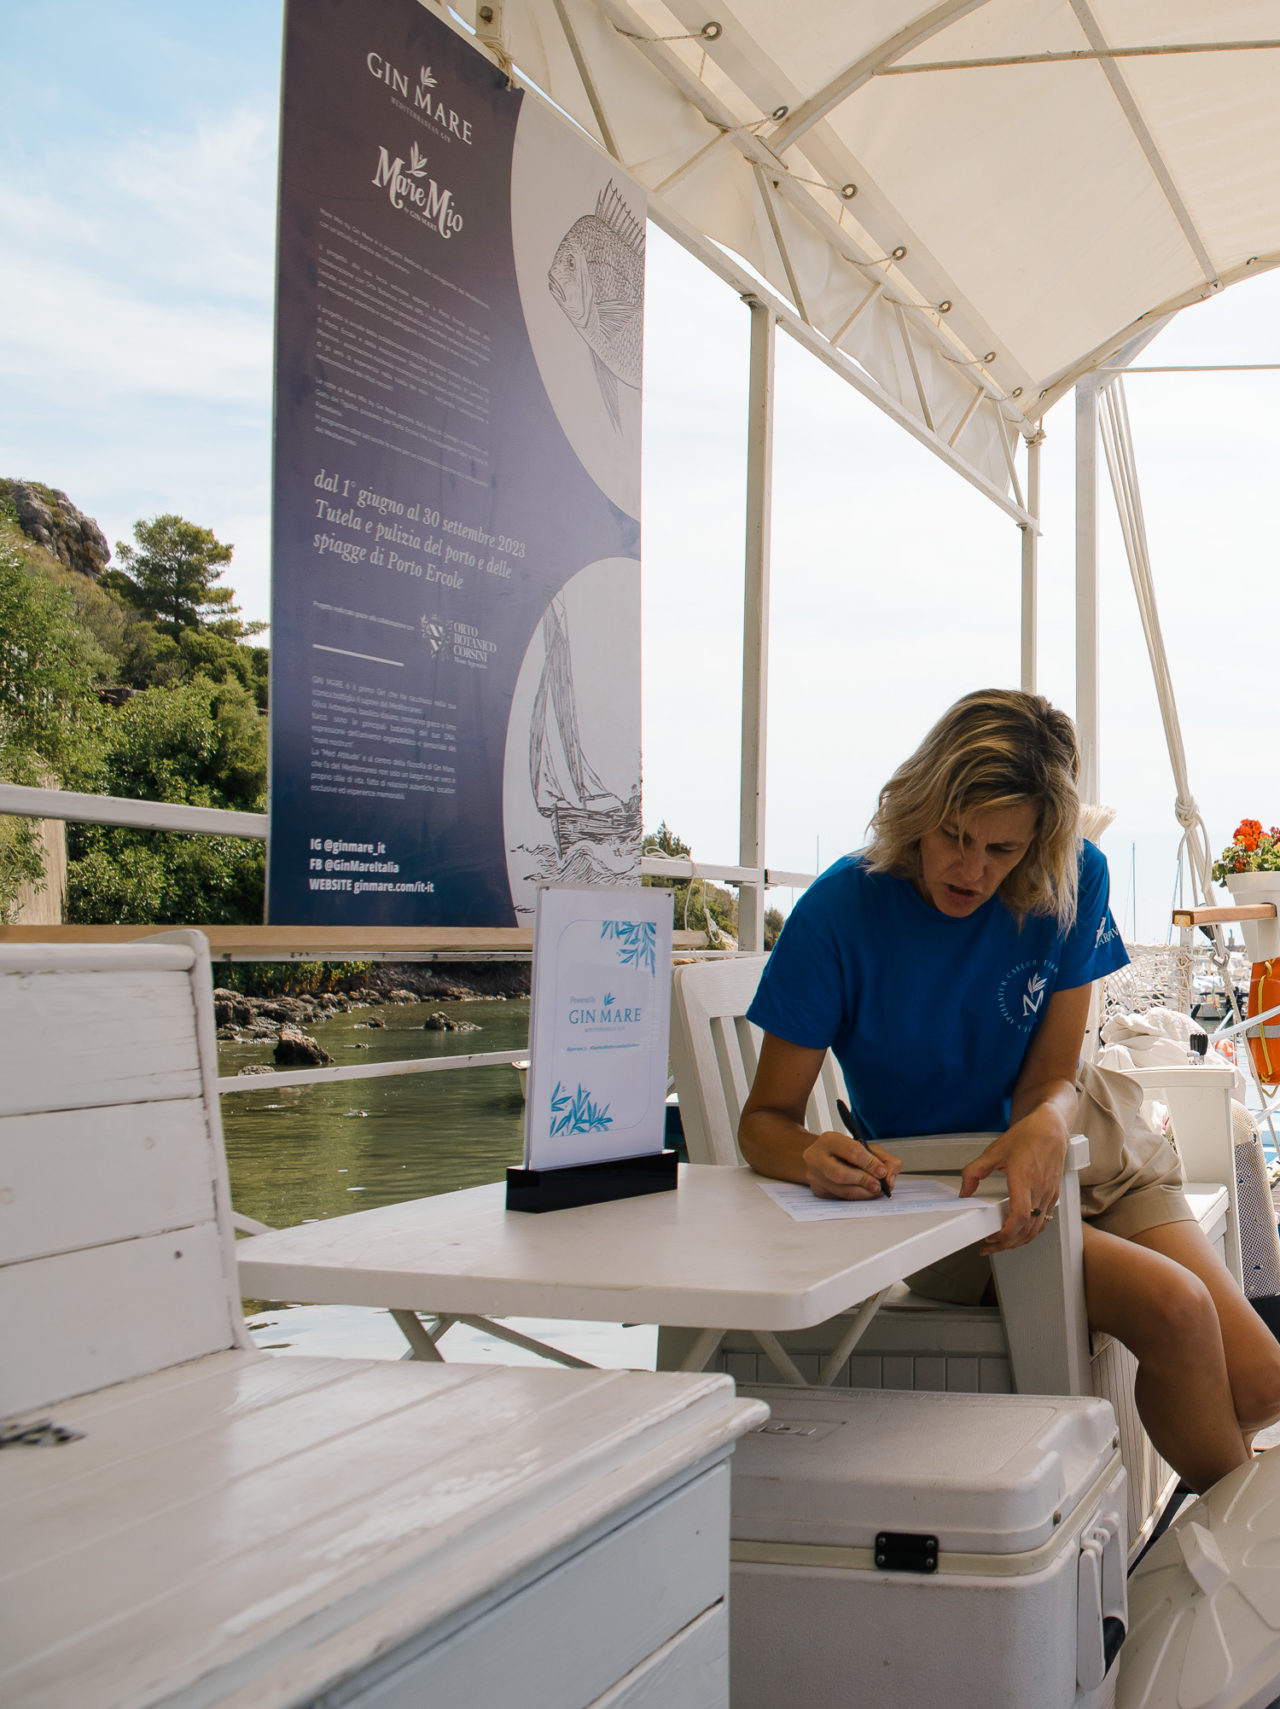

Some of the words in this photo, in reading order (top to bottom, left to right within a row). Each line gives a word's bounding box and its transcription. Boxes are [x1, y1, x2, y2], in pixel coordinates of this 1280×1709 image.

[367, 52, 409, 98] GIN
[413, 85, 473, 145] MARE
[371, 145, 426, 209] Mare
[422, 178, 463, 239] Mio
[314, 469, 338, 493] dal
[357, 486, 404, 515] giugno
[407, 504, 420, 521] al
[423, 507, 440, 528] 30
[442, 517, 495, 548] settembre
[498, 535, 526, 559] 2023
[315, 499, 361, 530] Tutela
[365, 521, 373, 533] e
[375, 522, 420, 549] pulizia
[424, 535, 443, 557] del
[445, 545, 475, 565] porto
[477, 557, 484, 570] e
[486, 556, 512, 579] delle
[313, 532, 366, 564] spiagge
[370, 546, 384, 566] di
[387, 552, 422, 578] Porto
[425, 563, 464, 590] Ercole
[453, 622, 478, 638] ORTO
[454, 633, 497, 653] BOTANICO
[310, 838, 322, 850] IG
[324, 839, 386, 856] @ginmare_it
[310, 858, 323, 870] FB
[324, 859, 400, 873] @GinMareItalia
[309, 878, 352, 891] WEBSITE
[353, 880, 434, 894] ginmare.com/it-it
[568, 1009, 595, 1025] GIN
[599, 1007, 642, 1023] MARE
